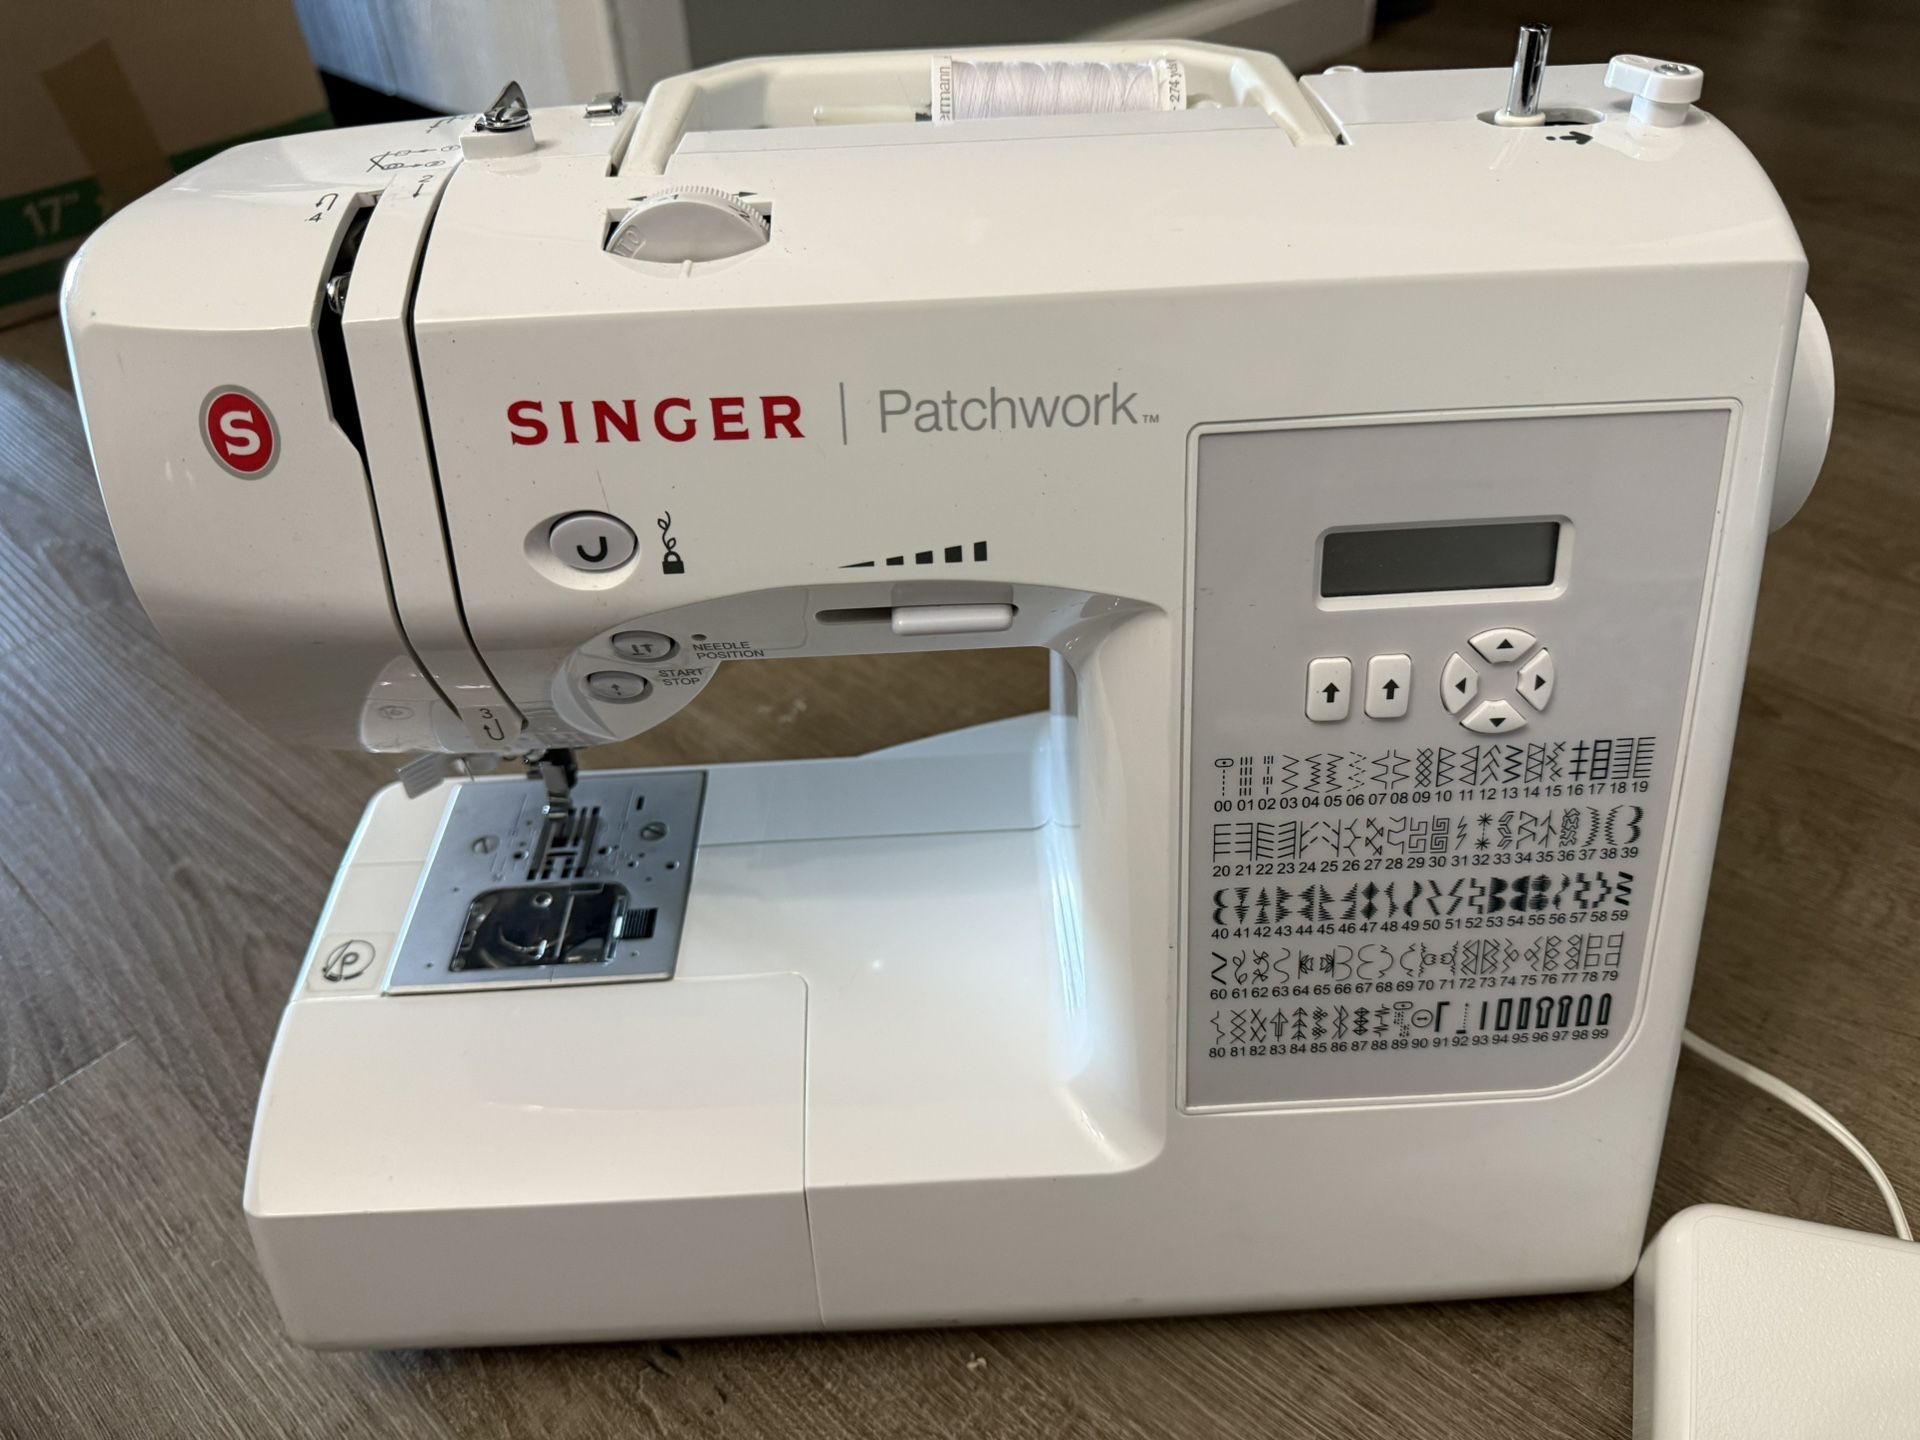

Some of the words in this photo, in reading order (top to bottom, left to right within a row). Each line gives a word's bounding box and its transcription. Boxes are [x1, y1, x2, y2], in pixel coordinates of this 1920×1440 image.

[1168, 79, 1181, 103] 274
[506, 395, 806, 447] SINGER
[878, 382, 1138, 434] Patchwork
[218, 409, 261, 456] S
[693, 641, 750, 651] NEEDLE
[697, 650, 765, 660] POSITION
[658, 668, 704, 678] START
[663, 677, 701, 686] STOP
[479, 708, 494, 719] 3
[1214, 800, 1232, 812] 00
[1237, 799, 1253, 811] 01
[1258, 798, 1276, 810] 02
[1280, 797, 1298, 809] 03
[1302, 796, 1320, 808] 04
[1324, 795, 1342, 807] 05
[1346, 794, 1365, 806] 06
[1368, 793, 1387, 805] 07
[1390, 792, 1408, 804] 08
[1412, 791, 1431, 803] 09
[1435, 790, 1452, 802] 10
[1459, 789, 1473, 801] 11
[1480, 788, 1496, 800] 12
[1502, 787, 1518, 799] 13
[1523, 786, 1540, 798] 14
[1545, 785, 1562, 797] 15
[1567, 784, 1584, 796] 16
[1589, 783, 1606, 795] 17
[1610, 782, 1627, 794] 18
[1632, 781, 1649, 792] 19
[1213, 865, 1230, 877] 20
[1235, 864, 1251, 876] 21
[1256, 863, 1273, 875] 22
[1277, 862, 1295, 874] 23
[1298, 862, 1316, 873] 24
[1320, 860, 1338, 872] 25
[1342, 860, 1360, 871] 26
[1364, 859, 1382, 870] 27
[1385, 858, 1403, 870] 28
[1406, 857, 1425, 869] 29
[1428, 856, 1447, 868] 30
[1451, 855, 1467, 867] 31
[1472, 854, 1490, 866] 32
[1493, 853, 1511, 865] 33
[1515, 852, 1533, 864] 34
[1536, 851, 1554, 863] 35
[1557, 850, 1575, 862] 36
[1578, 849, 1597, 861] 37
[1600, 848, 1618, 859] 38
[1620, 847, 1639, 858] 39
[1211, 928, 1229, 940] 40
[1233, 927, 1249, 938] 41
[1253, 926, 1271, 938] 42
[1274, 925, 1292, 936] 43
[1295, 925, 1313, 935] 44
[1317, 923, 1335, 935] 45
[1338, 923, 1356, 934] 46
[1359, 922, 1378, 933] 47
[1380, 921, 1398, 932] 48
[1401, 920, 1420, 931] 49
[1422, 919, 1441, 931] 50
[1445, 918, 1462, 930] 51
[1465, 917, 1483, 929] 52
[1486, 916, 1504, 928] 53
[1507, 915, 1525, 927] 54
[1528, 914, 1546, 925] 55
[1548, 913, 1566, 924] 56
[1569, 912, 1588, 923] 57
[1590, 911, 1608, 922] 58
[1610, 910, 1629, 921] 59
[1210, 989, 1227, 1000] 60
[1232, 988, 1247, 999] 61
[1251, 987, 1268, 998] 62
[1272, 986, 1289, 997] 63
[1292, 985, 1309, 996] 64
[1313, 984, 1331, 995] 65
[1334, 983, 1352, 995] 66
[1355, 982, 1373, 994] 67
[1376, 981, 1394, 993] 68
[1396, 981, 1415, 992] 69
[1418, 980, 1435, 991] 70
[1439, 979, 1456, 990] 71
[1459, 978, 1477, 989] 72
[1480, 977, 1497, 988] 73
[1500, 976, 1517, 986] 74
[1521, 975, 1537, 985] 75
[1541, 974, 1558, 984] 76
[1561, 972, 1579, 983] 77
[1582, 971, 1598, 982] 78
[1602, 970, 1619, 981] 79
[1209, 1047, 1226, 1058] 80
[1230, 1046, 1245, 1057] 81
[1249, 1045, 1266, 1056] 82
[1270, 1044, 1286, 1055] 83
[1290, 1043, 1306, 1054] 84
[1310, 1042, 1327, 1053] 85
[1330, 1041, 1348, 1052] 86
[1351, 1041, 1369, 1052] 87
[1371, 1040, 1389, 1051] 88
[1391, 1039, 1409, 1050] 89
[1411, 1038, 1429, 1049] 90
[1433, 1037, 1449, 1048] 91
[1452, 1036, 1470, 1047] 92
[1472, 1035, 1490, 1046] 93
[1492, 1034, 1509, 1045] 94
[1512, 1033, 1529, 1044] 95
[1532, 1032, 1549, 1042] 96
[1552, 1031, 1570, 1041] 97
[1572, 1029, 1589, 1040] 98
[1592, 1028, 1608, 1039] 99
